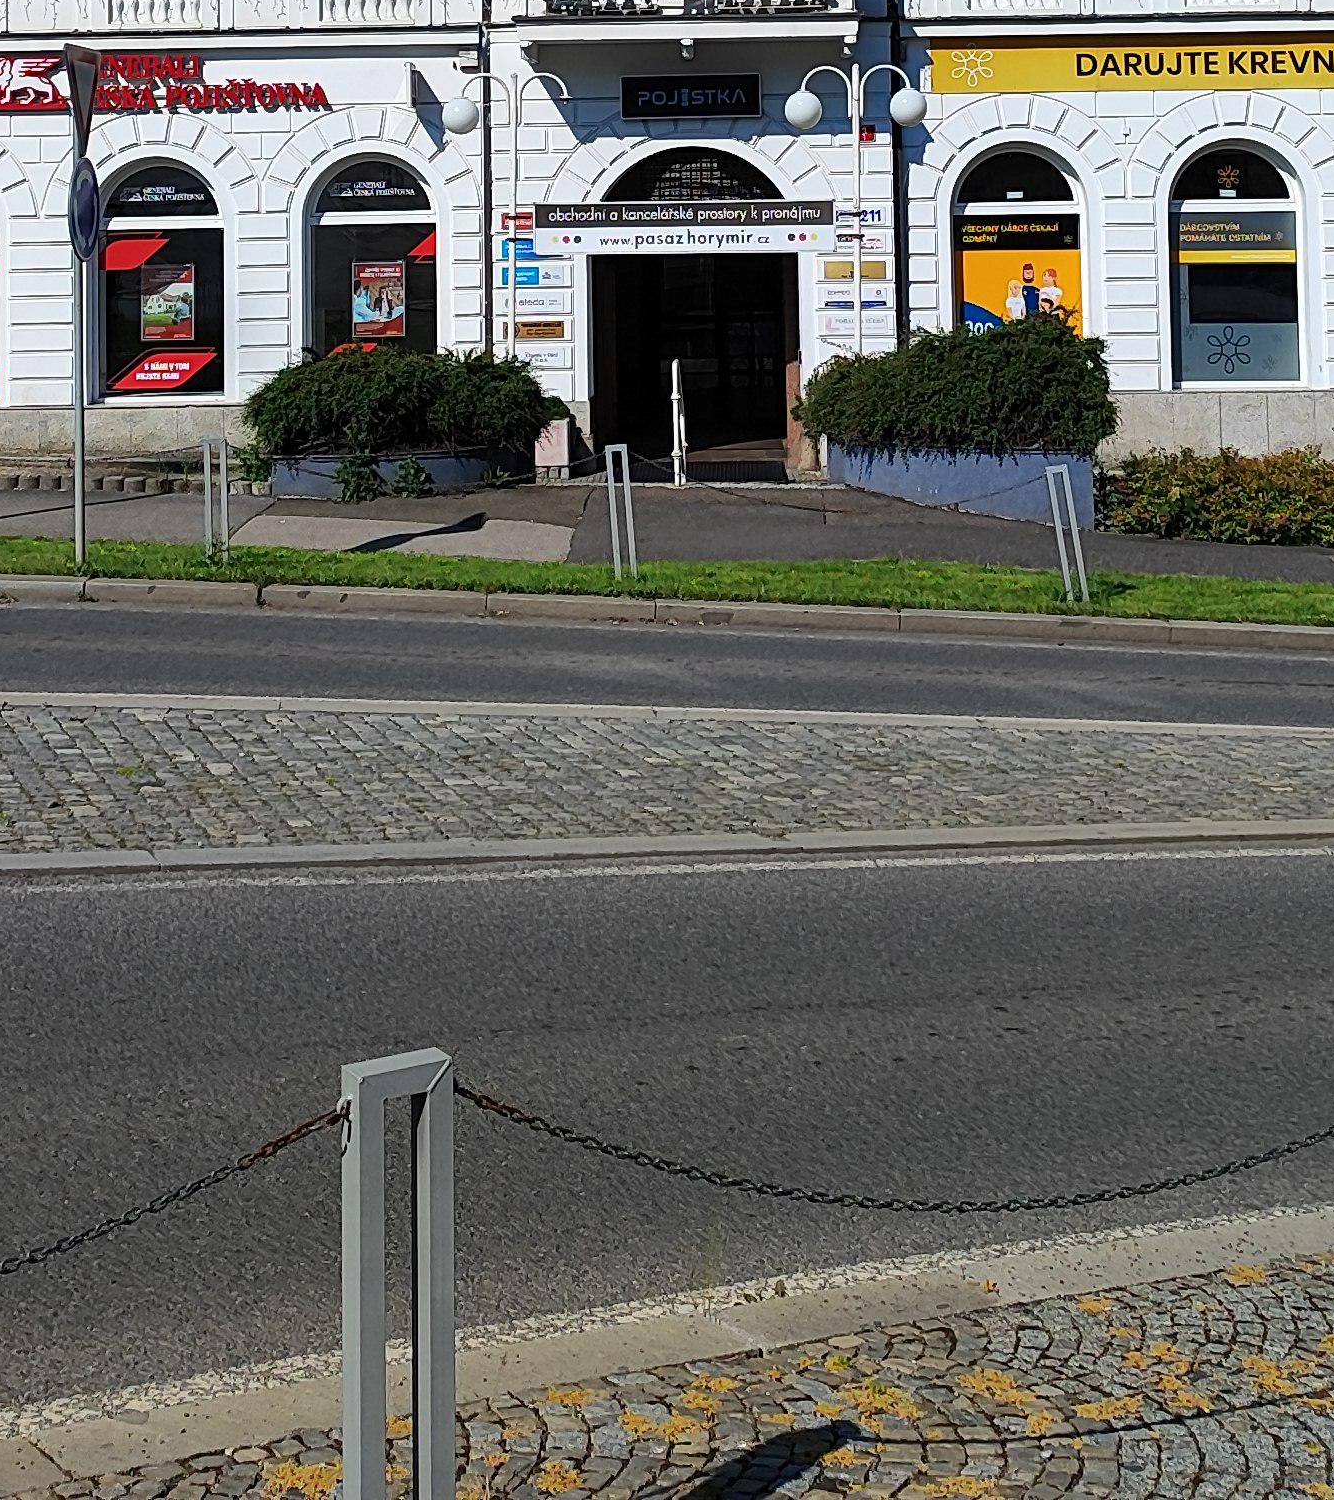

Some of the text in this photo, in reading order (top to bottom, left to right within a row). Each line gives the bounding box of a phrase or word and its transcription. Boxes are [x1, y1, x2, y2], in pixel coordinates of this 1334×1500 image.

[100, 55, 201, 79] ENERALI
[1076, 52, 1219, 77] DARUJTE
[166, 78, 329, 111] POJIŠŤOVNA
[548, 206, 606, 222] obchodní
[610, 211, 618, 222] a
[622, 205, 694, 221] kancelářské
[698, 206, 747, 223] prostory
[751, 205, 758, 220] k
[762, 205, 820, 223] pronájmu
